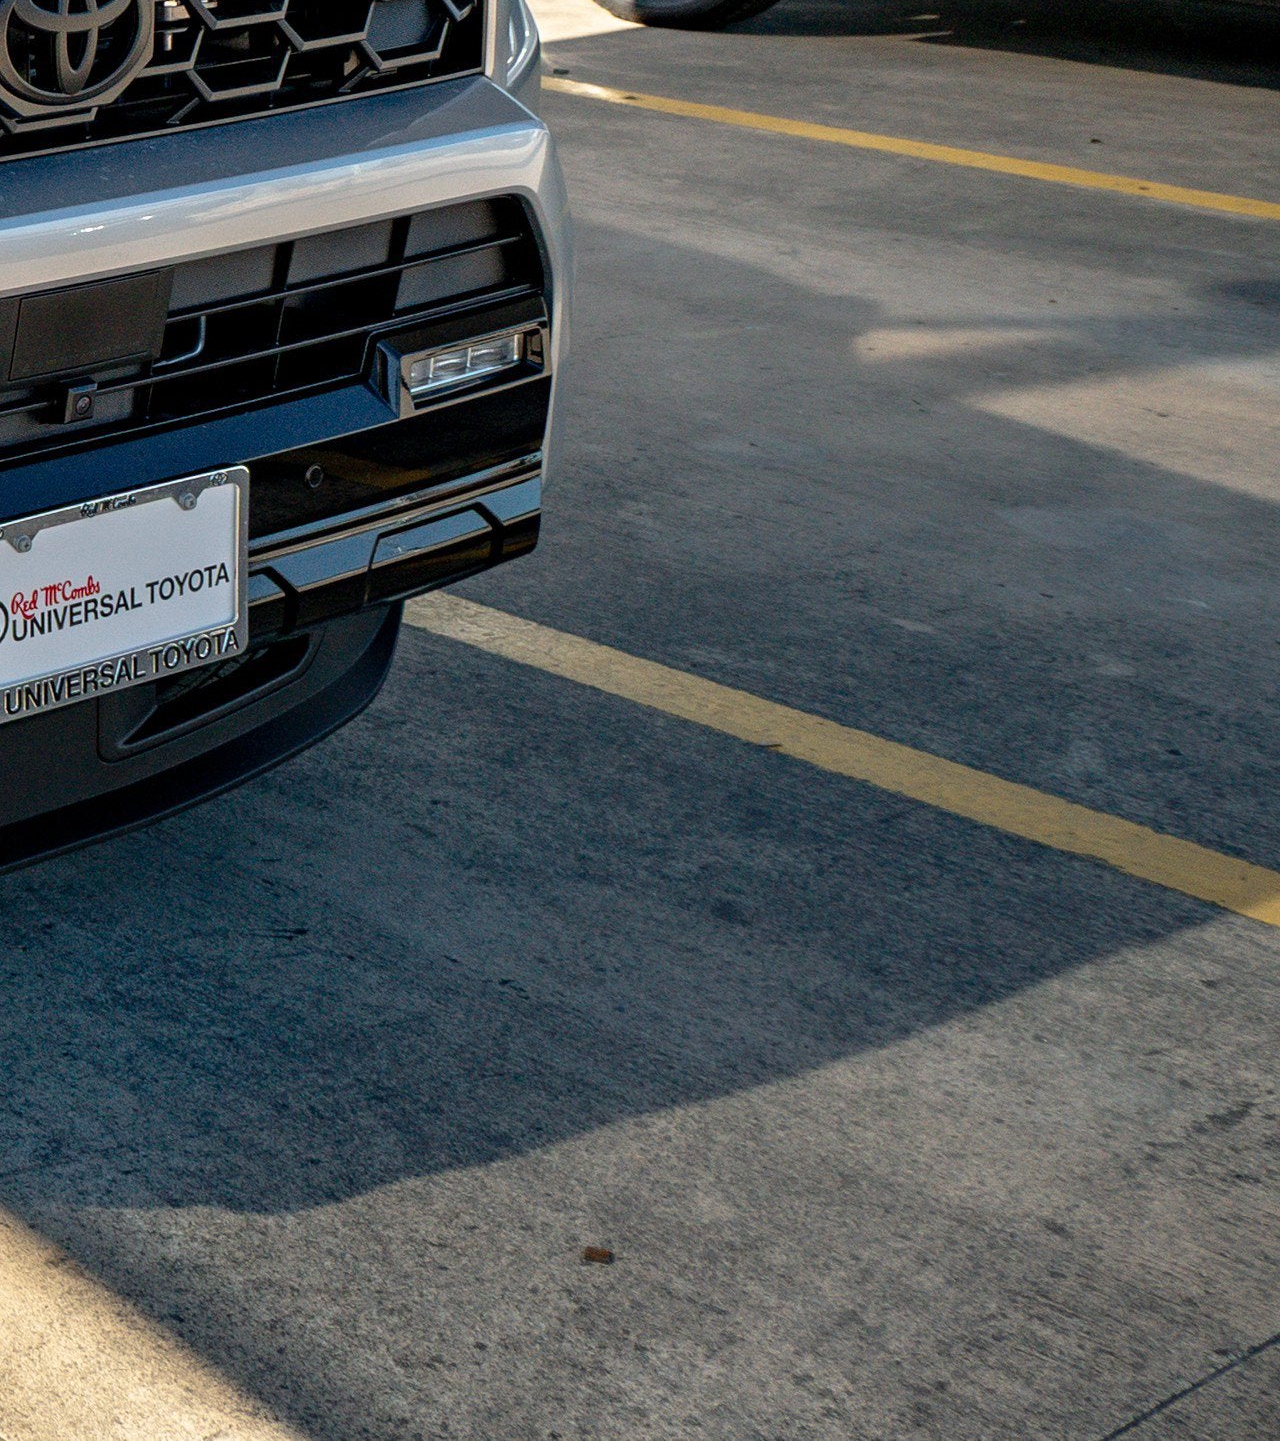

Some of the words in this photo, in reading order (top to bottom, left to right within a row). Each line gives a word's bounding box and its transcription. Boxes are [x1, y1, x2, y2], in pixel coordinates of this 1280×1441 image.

[11, 589, 38, 620] Red
[40, 575, 101, 606] McCombs
[12, 587, 142, 642] UNIVERSAL
[145, 562, 230, 604] TOYOTA
[4, 652, 146, 716] UNIVERSAL
[147, 626, 239, 675] TOYOTA
